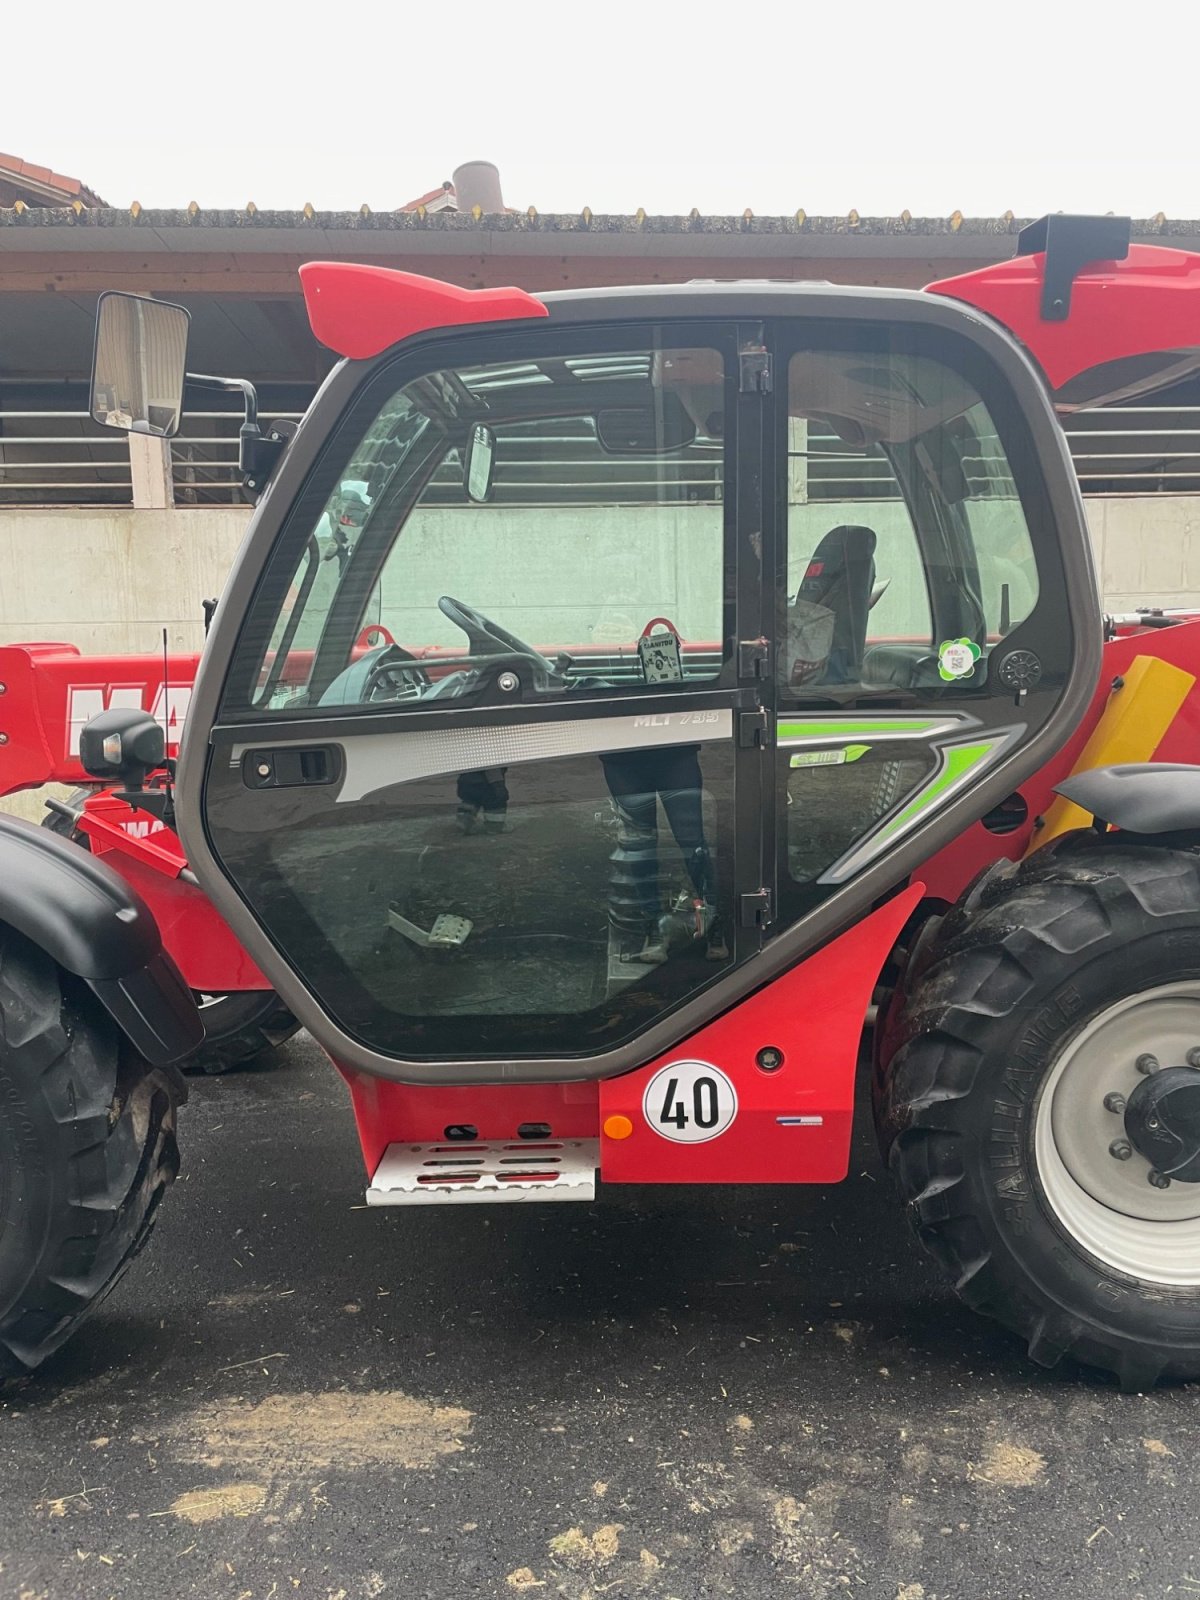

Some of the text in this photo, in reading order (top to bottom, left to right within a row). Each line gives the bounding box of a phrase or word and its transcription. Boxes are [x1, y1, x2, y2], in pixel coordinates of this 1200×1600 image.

[634, 715, 671, 728] MLT
[660, 1077, 720, 1130] 40
[989, 984, 1082, 1202] ALLIANCE
